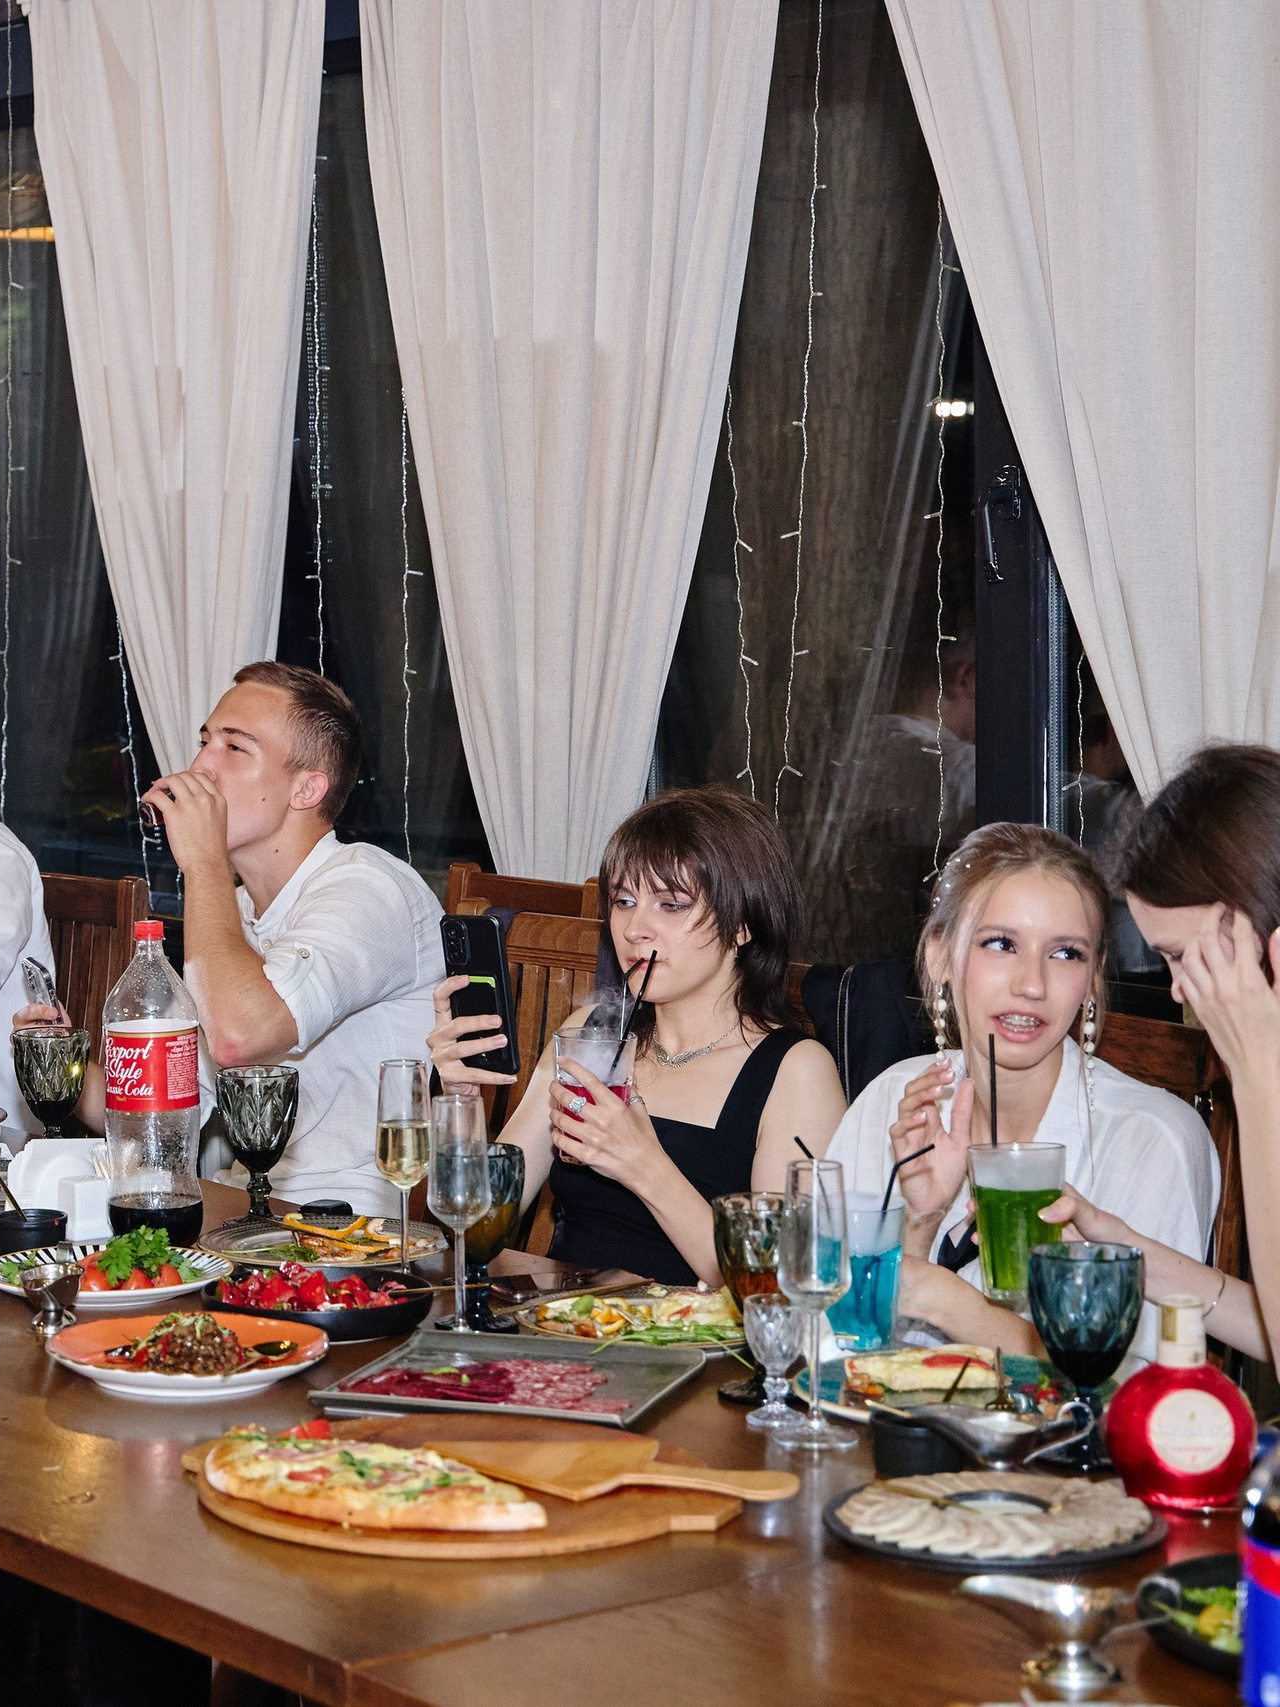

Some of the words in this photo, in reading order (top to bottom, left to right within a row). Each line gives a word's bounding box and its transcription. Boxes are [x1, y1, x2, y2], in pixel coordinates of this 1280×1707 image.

[108, 1058, 143, 1085] Style
[107, 1082, 123, 1095] lassic
[124, 1079, 154, 1096] Cola
